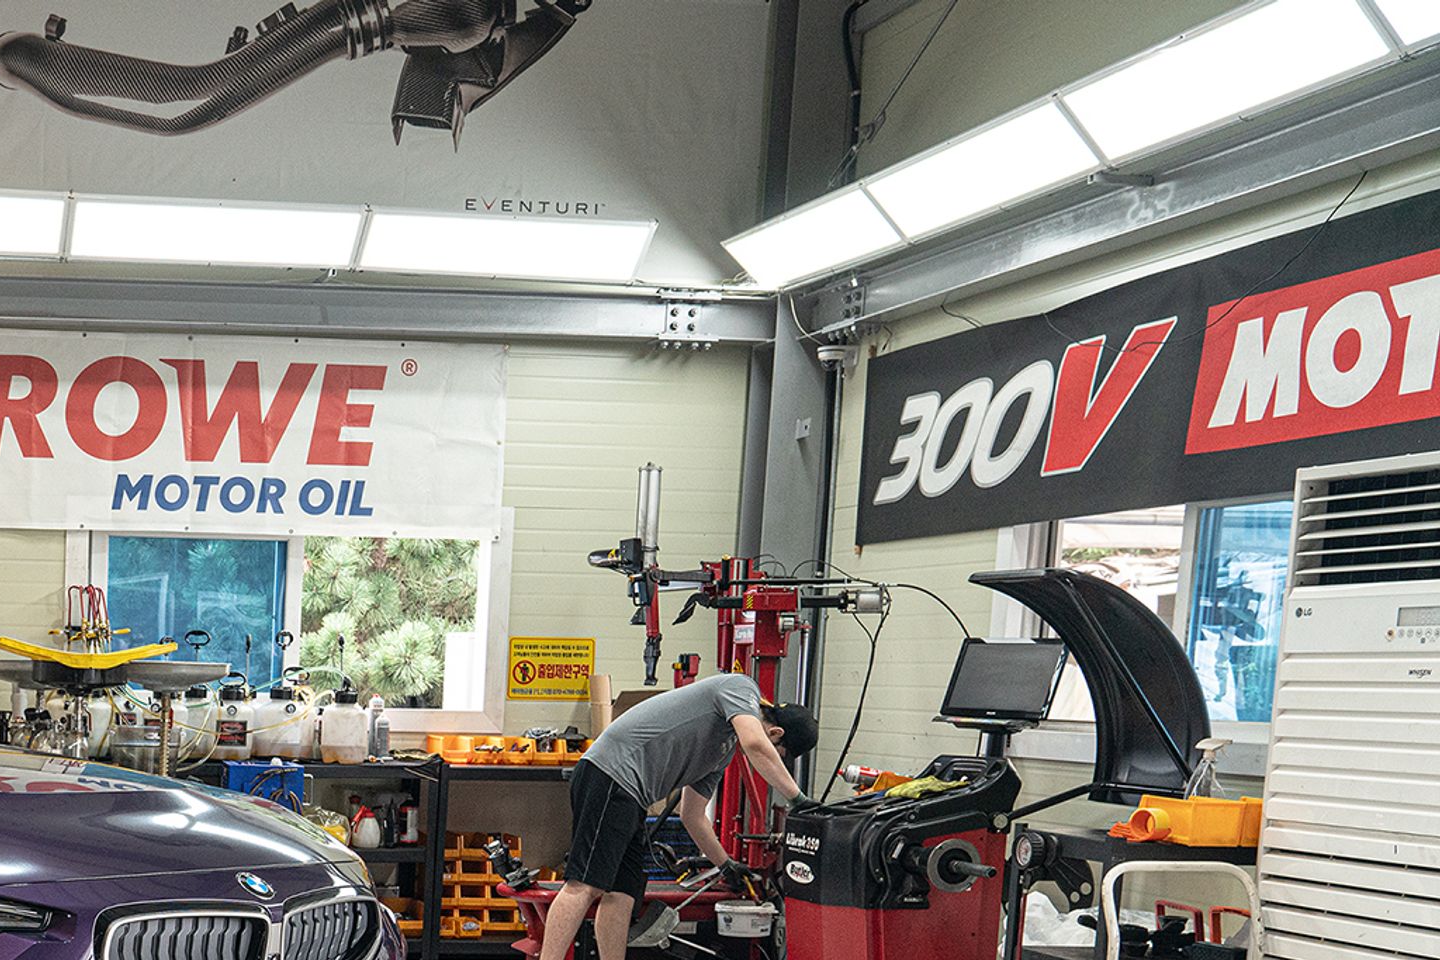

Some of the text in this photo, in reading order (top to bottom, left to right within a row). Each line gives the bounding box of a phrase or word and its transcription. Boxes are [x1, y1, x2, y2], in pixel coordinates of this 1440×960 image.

[465, 196, 598, 215] EVENTURI
[873, 316, 1178, 505] 300V
[111, 474, 374, 516] MOTOR OIL
[1303, 607, 1313, 616] LG
[538, 664, 590, 679] 출입제한구역
